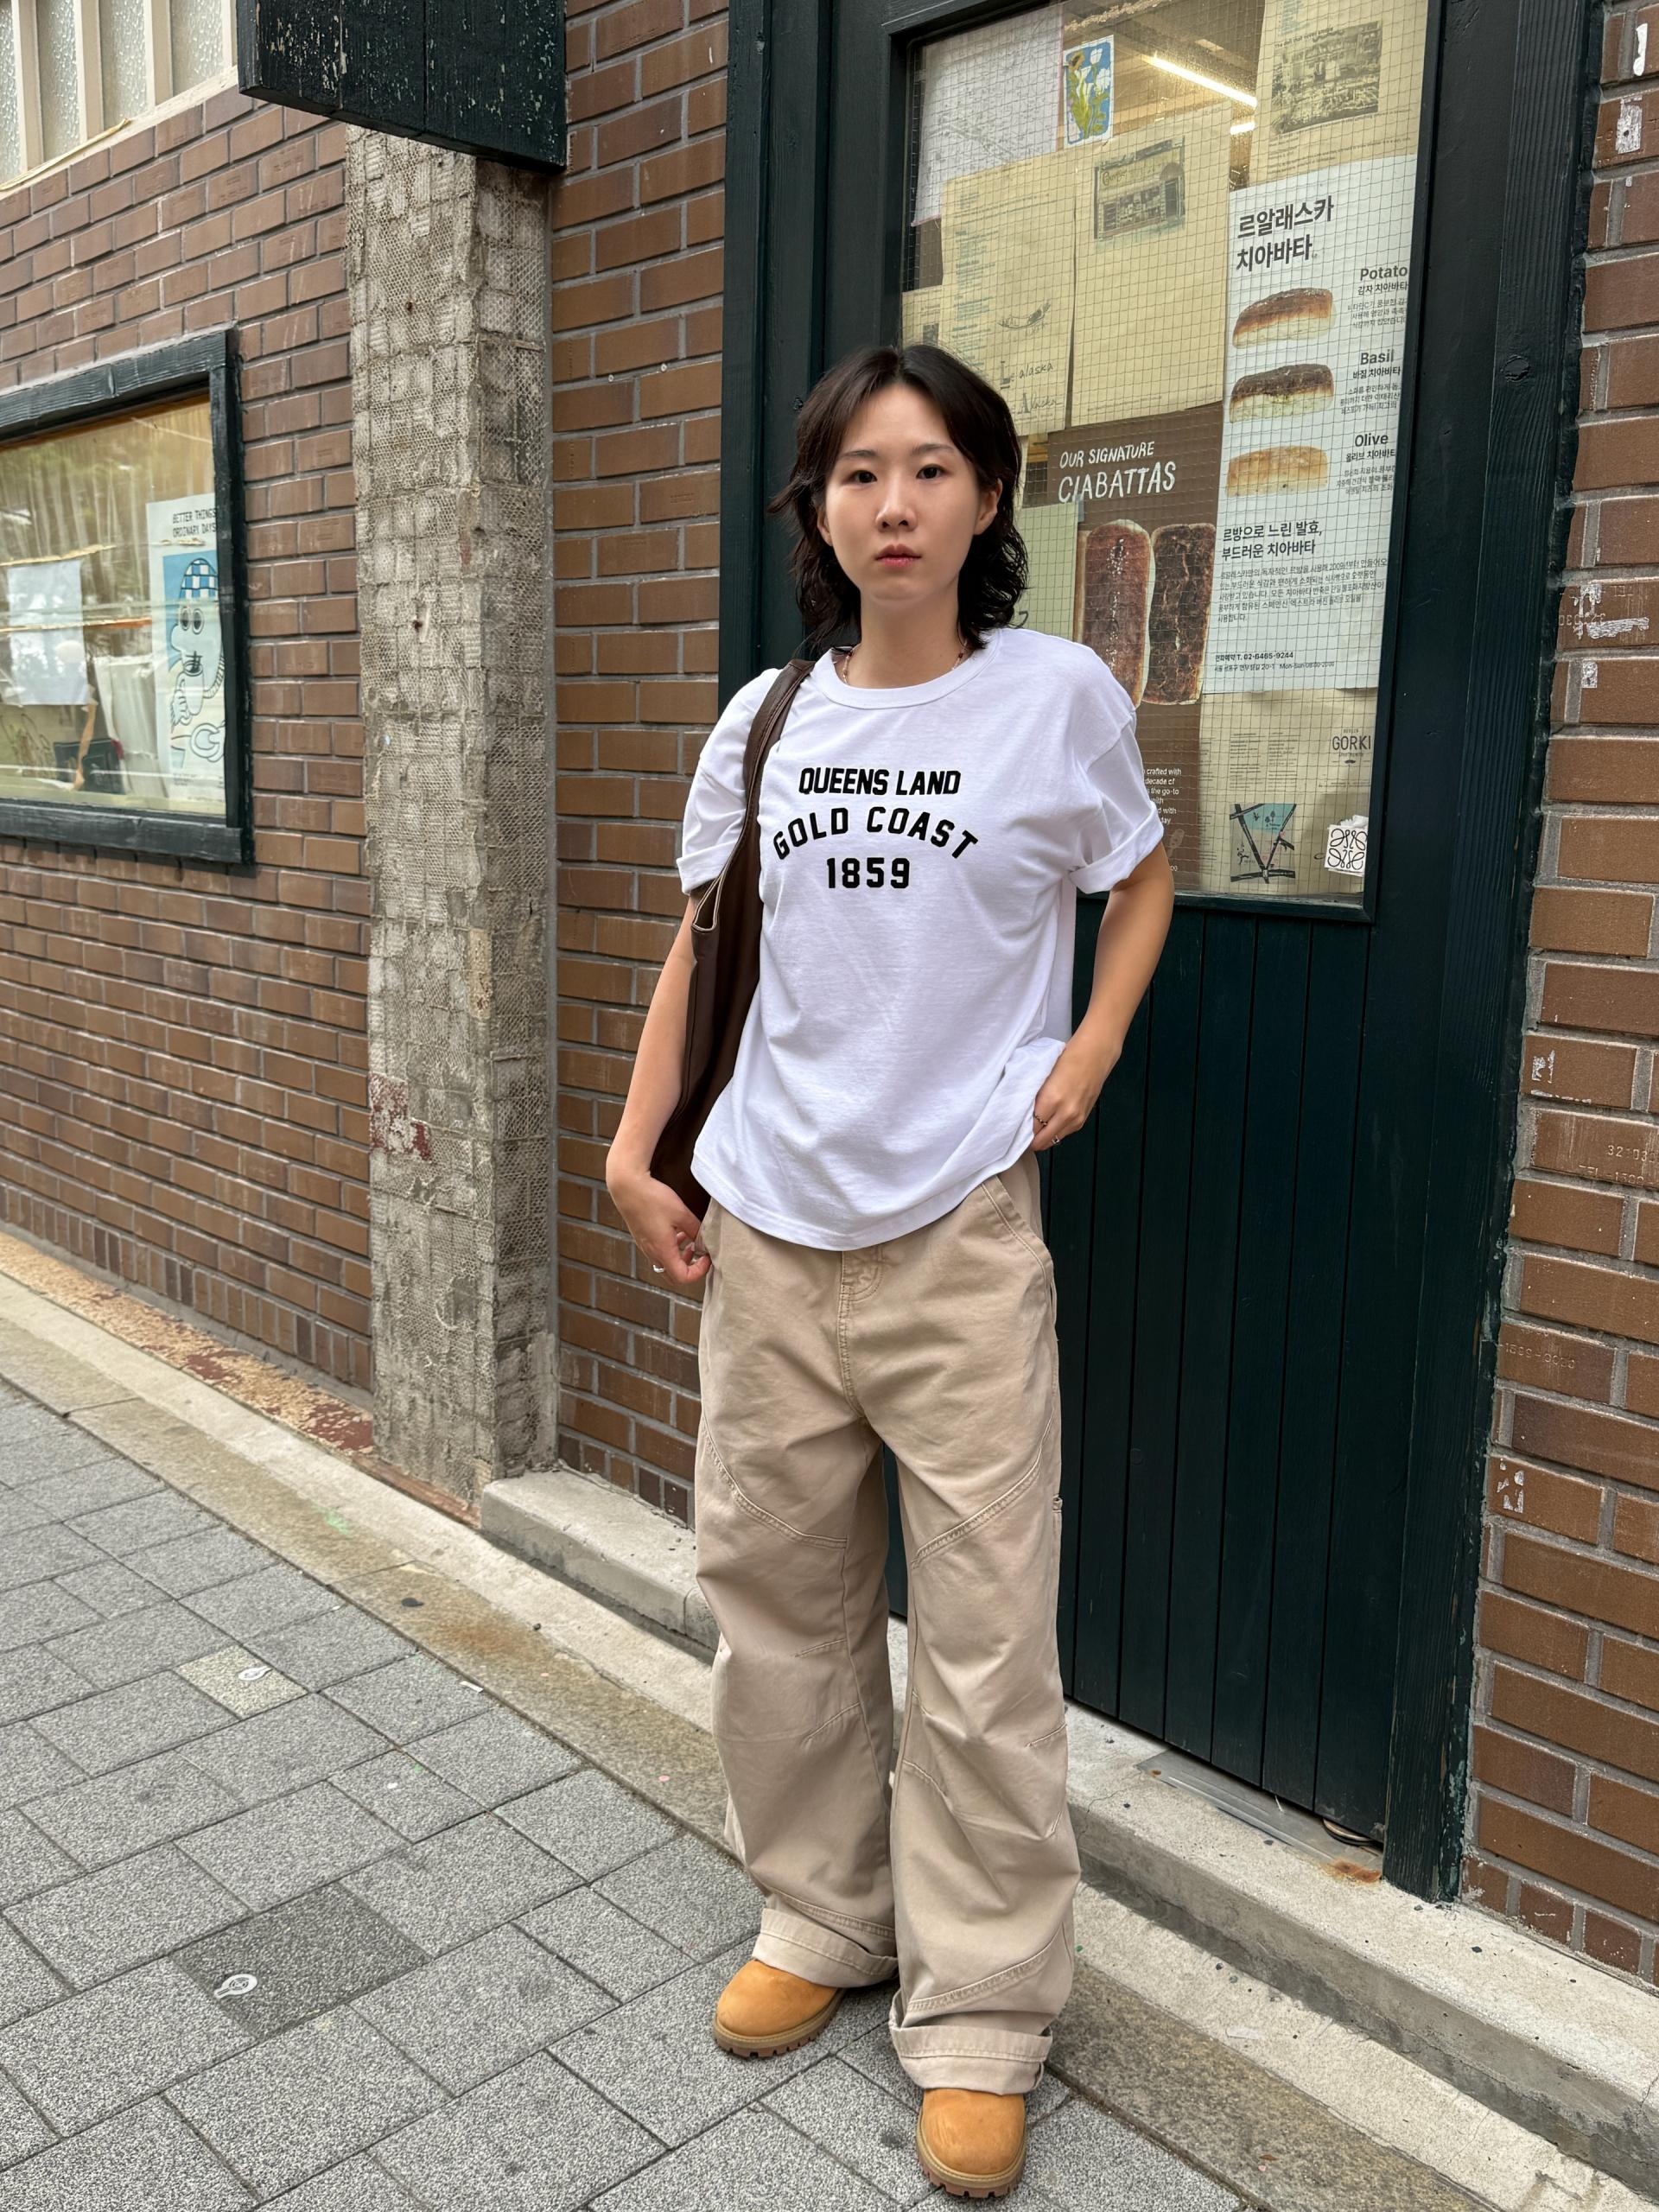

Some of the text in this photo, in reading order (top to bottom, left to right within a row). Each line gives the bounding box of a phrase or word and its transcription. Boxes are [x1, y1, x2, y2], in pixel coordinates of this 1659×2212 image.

[1237, 195, 1334, 238] 르알래스카
[1236, 234, 1313, 272] 치아바타
[1360, 265, 1408, 281] Potato
[1357, 281, 1410, 296] 감자 치아바타
[1360, 349, 1395, 365] Basil
[1019, 362, 1054, 378] alaska
[1353, 366, 1401, 378] 바질 치아바타
[1355, 433, 1389, 448] Olive
[1059, 441, 1155, 469] OUR SIGNATURE
[1345, 452, 1365, 463] 올리브
[1058, 461, 1177, 504] CIABATTAS
[173, 511, 192, 524] BETTER
[173, 524, 200, 537] ORDINARY
[1224, 519, 1322, 542] 르방으로 느린 발효,
[1222, 539, 1316, 562] 부드러운 치아바타
[1231, 580, 1255, 589] 부드러운
[1257, 579, 1276, 588] 식감과
[1278, 576, 1298, 587] 편하게
[1351, 569, 1376, 580] 오랫동안
[1262, 566, 1287, 576] 독자적인
[1271, 588, 1284, 598] 모든
[1286, 587, 1312, 597] 치아바타
[1313, 585, 1330, 595] 반죽은
[1290, 597, 1314, 607] 엑스트라
[1316, 597, 1328, 606] 버진
[1244, 652, 1294, 661] 02-6465-9244
[1332, 735, 1371, 751] GORKI
[798, 767, 962, 796] QUEENS LAND
[1162, 788, 1179, 797] go-to
[773, 806, 978, 860] GOLD COAST
[827, 857, 910, 889] 1859
